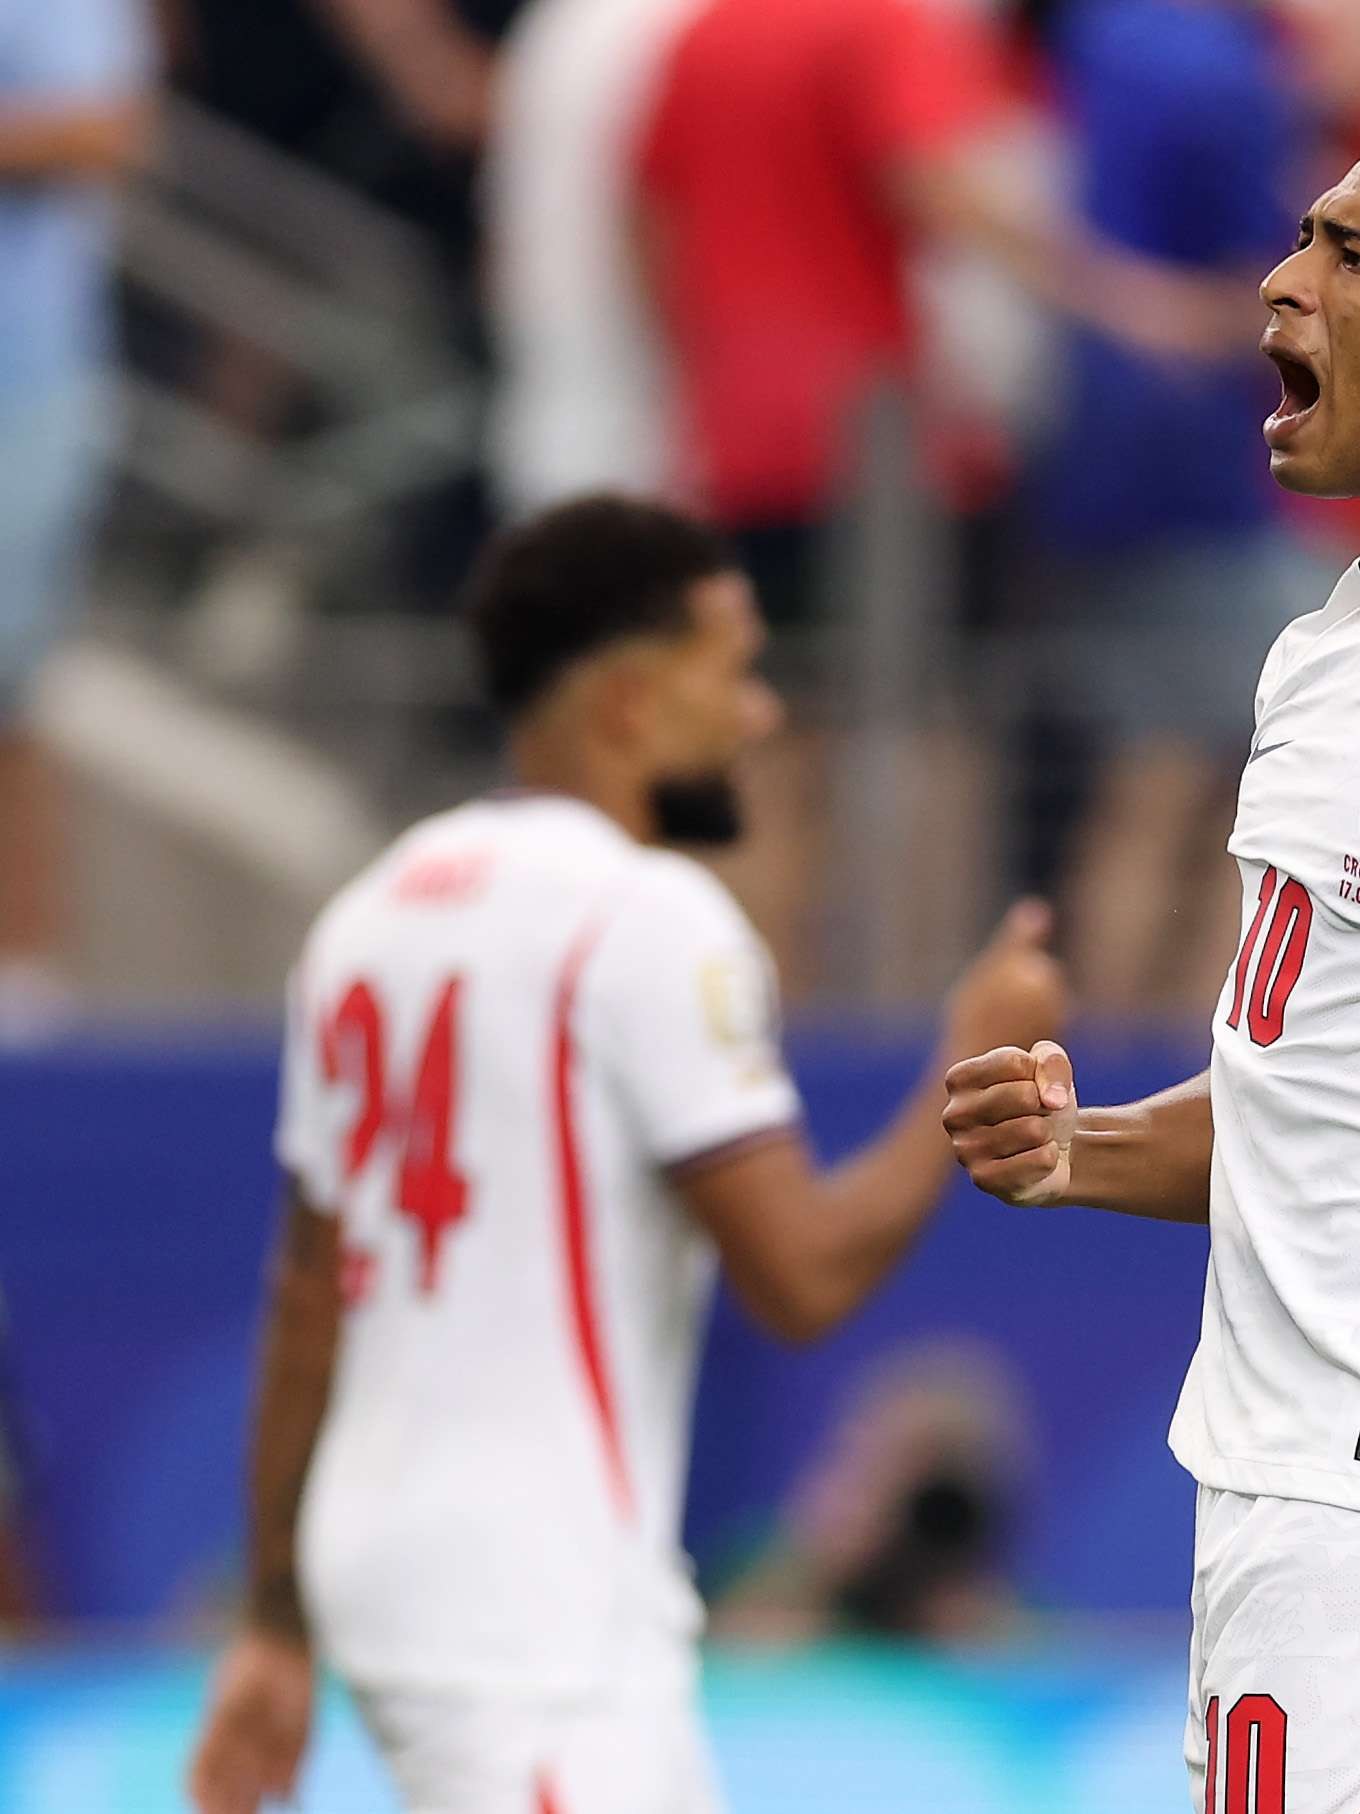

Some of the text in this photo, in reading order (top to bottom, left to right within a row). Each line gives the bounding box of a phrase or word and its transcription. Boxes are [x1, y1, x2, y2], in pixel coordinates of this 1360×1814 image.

[1226, 864, 1313, 1048] 10
[318, 972, 472, 1304] 24
[1205, 1693, 1288, 1814] 10
